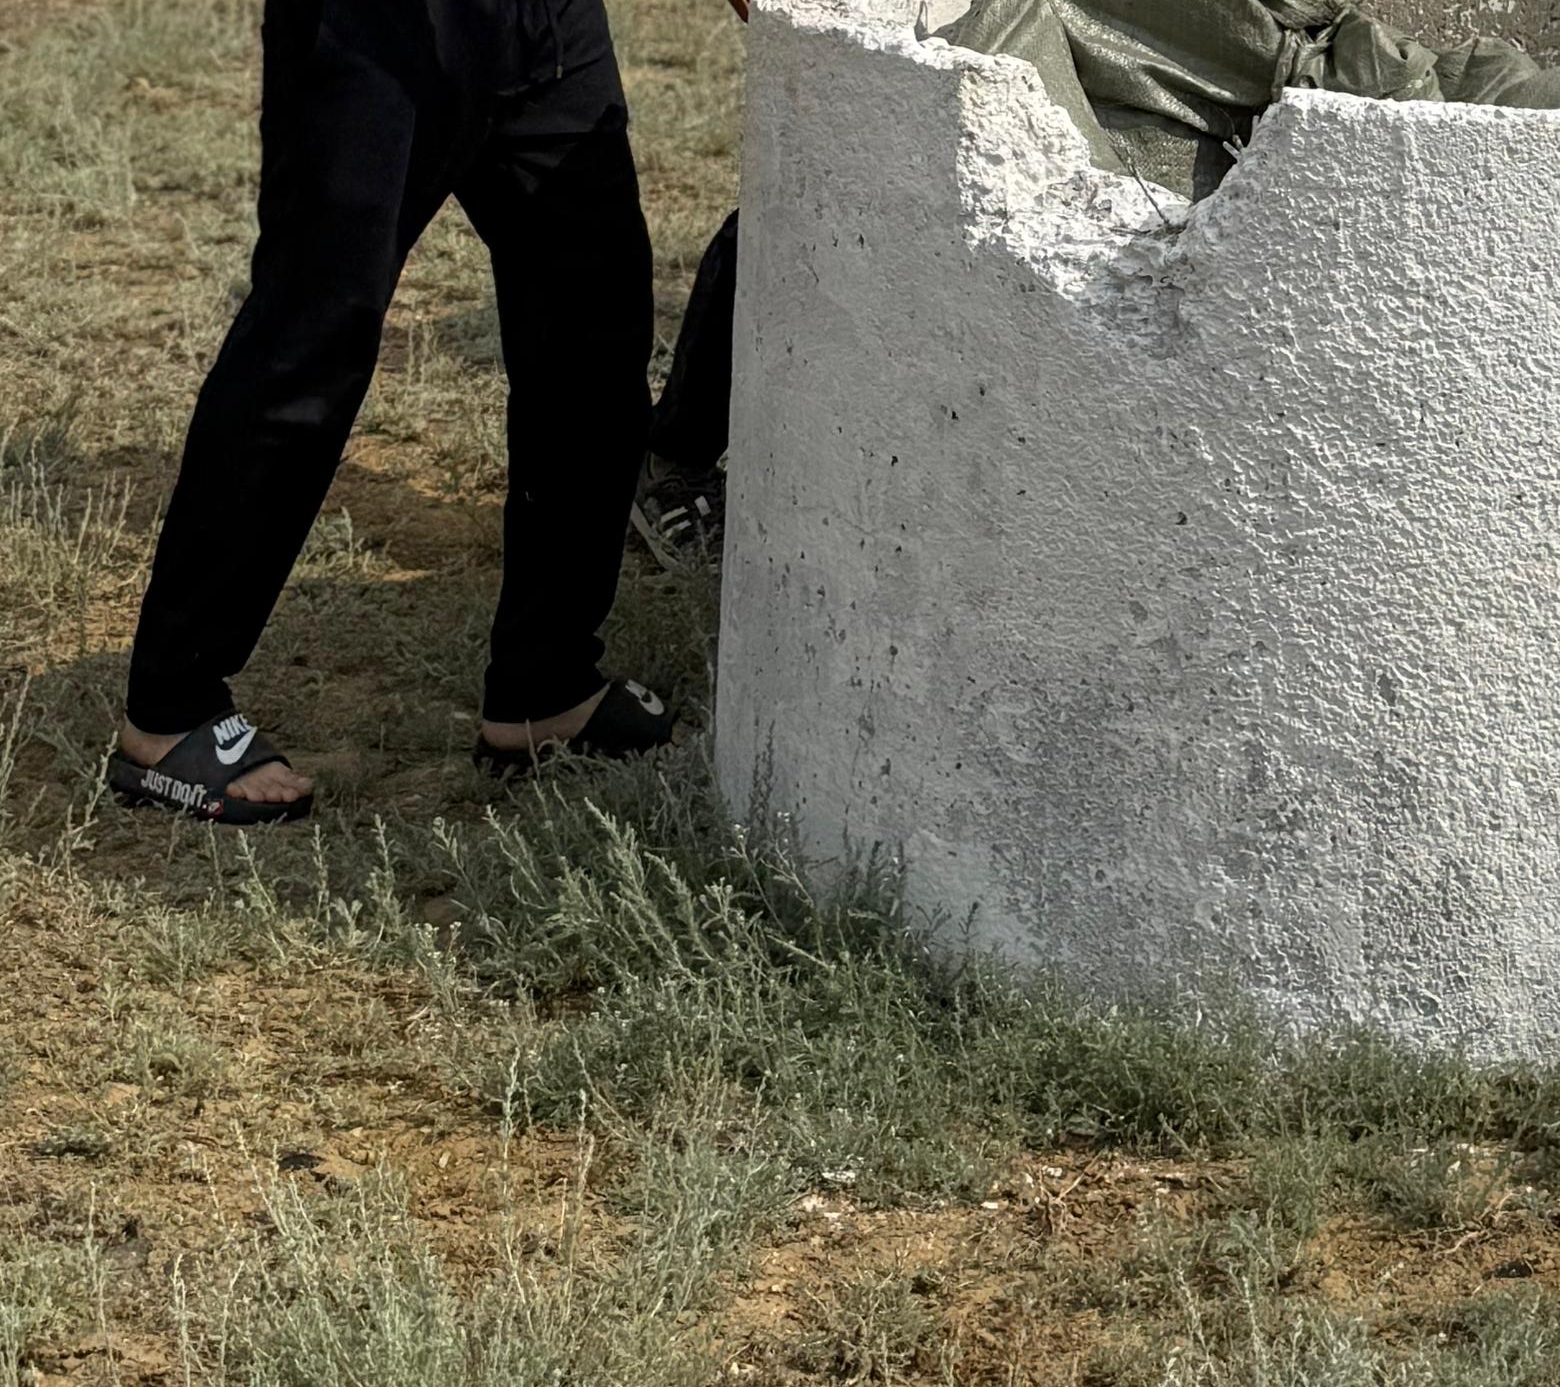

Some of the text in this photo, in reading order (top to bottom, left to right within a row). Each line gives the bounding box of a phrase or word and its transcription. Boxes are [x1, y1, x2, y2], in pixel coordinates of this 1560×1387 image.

[213, 714, 253, 745] NIKE
[141, 769, 173, 796] JUST
[170, 779, 192, 804] DO
